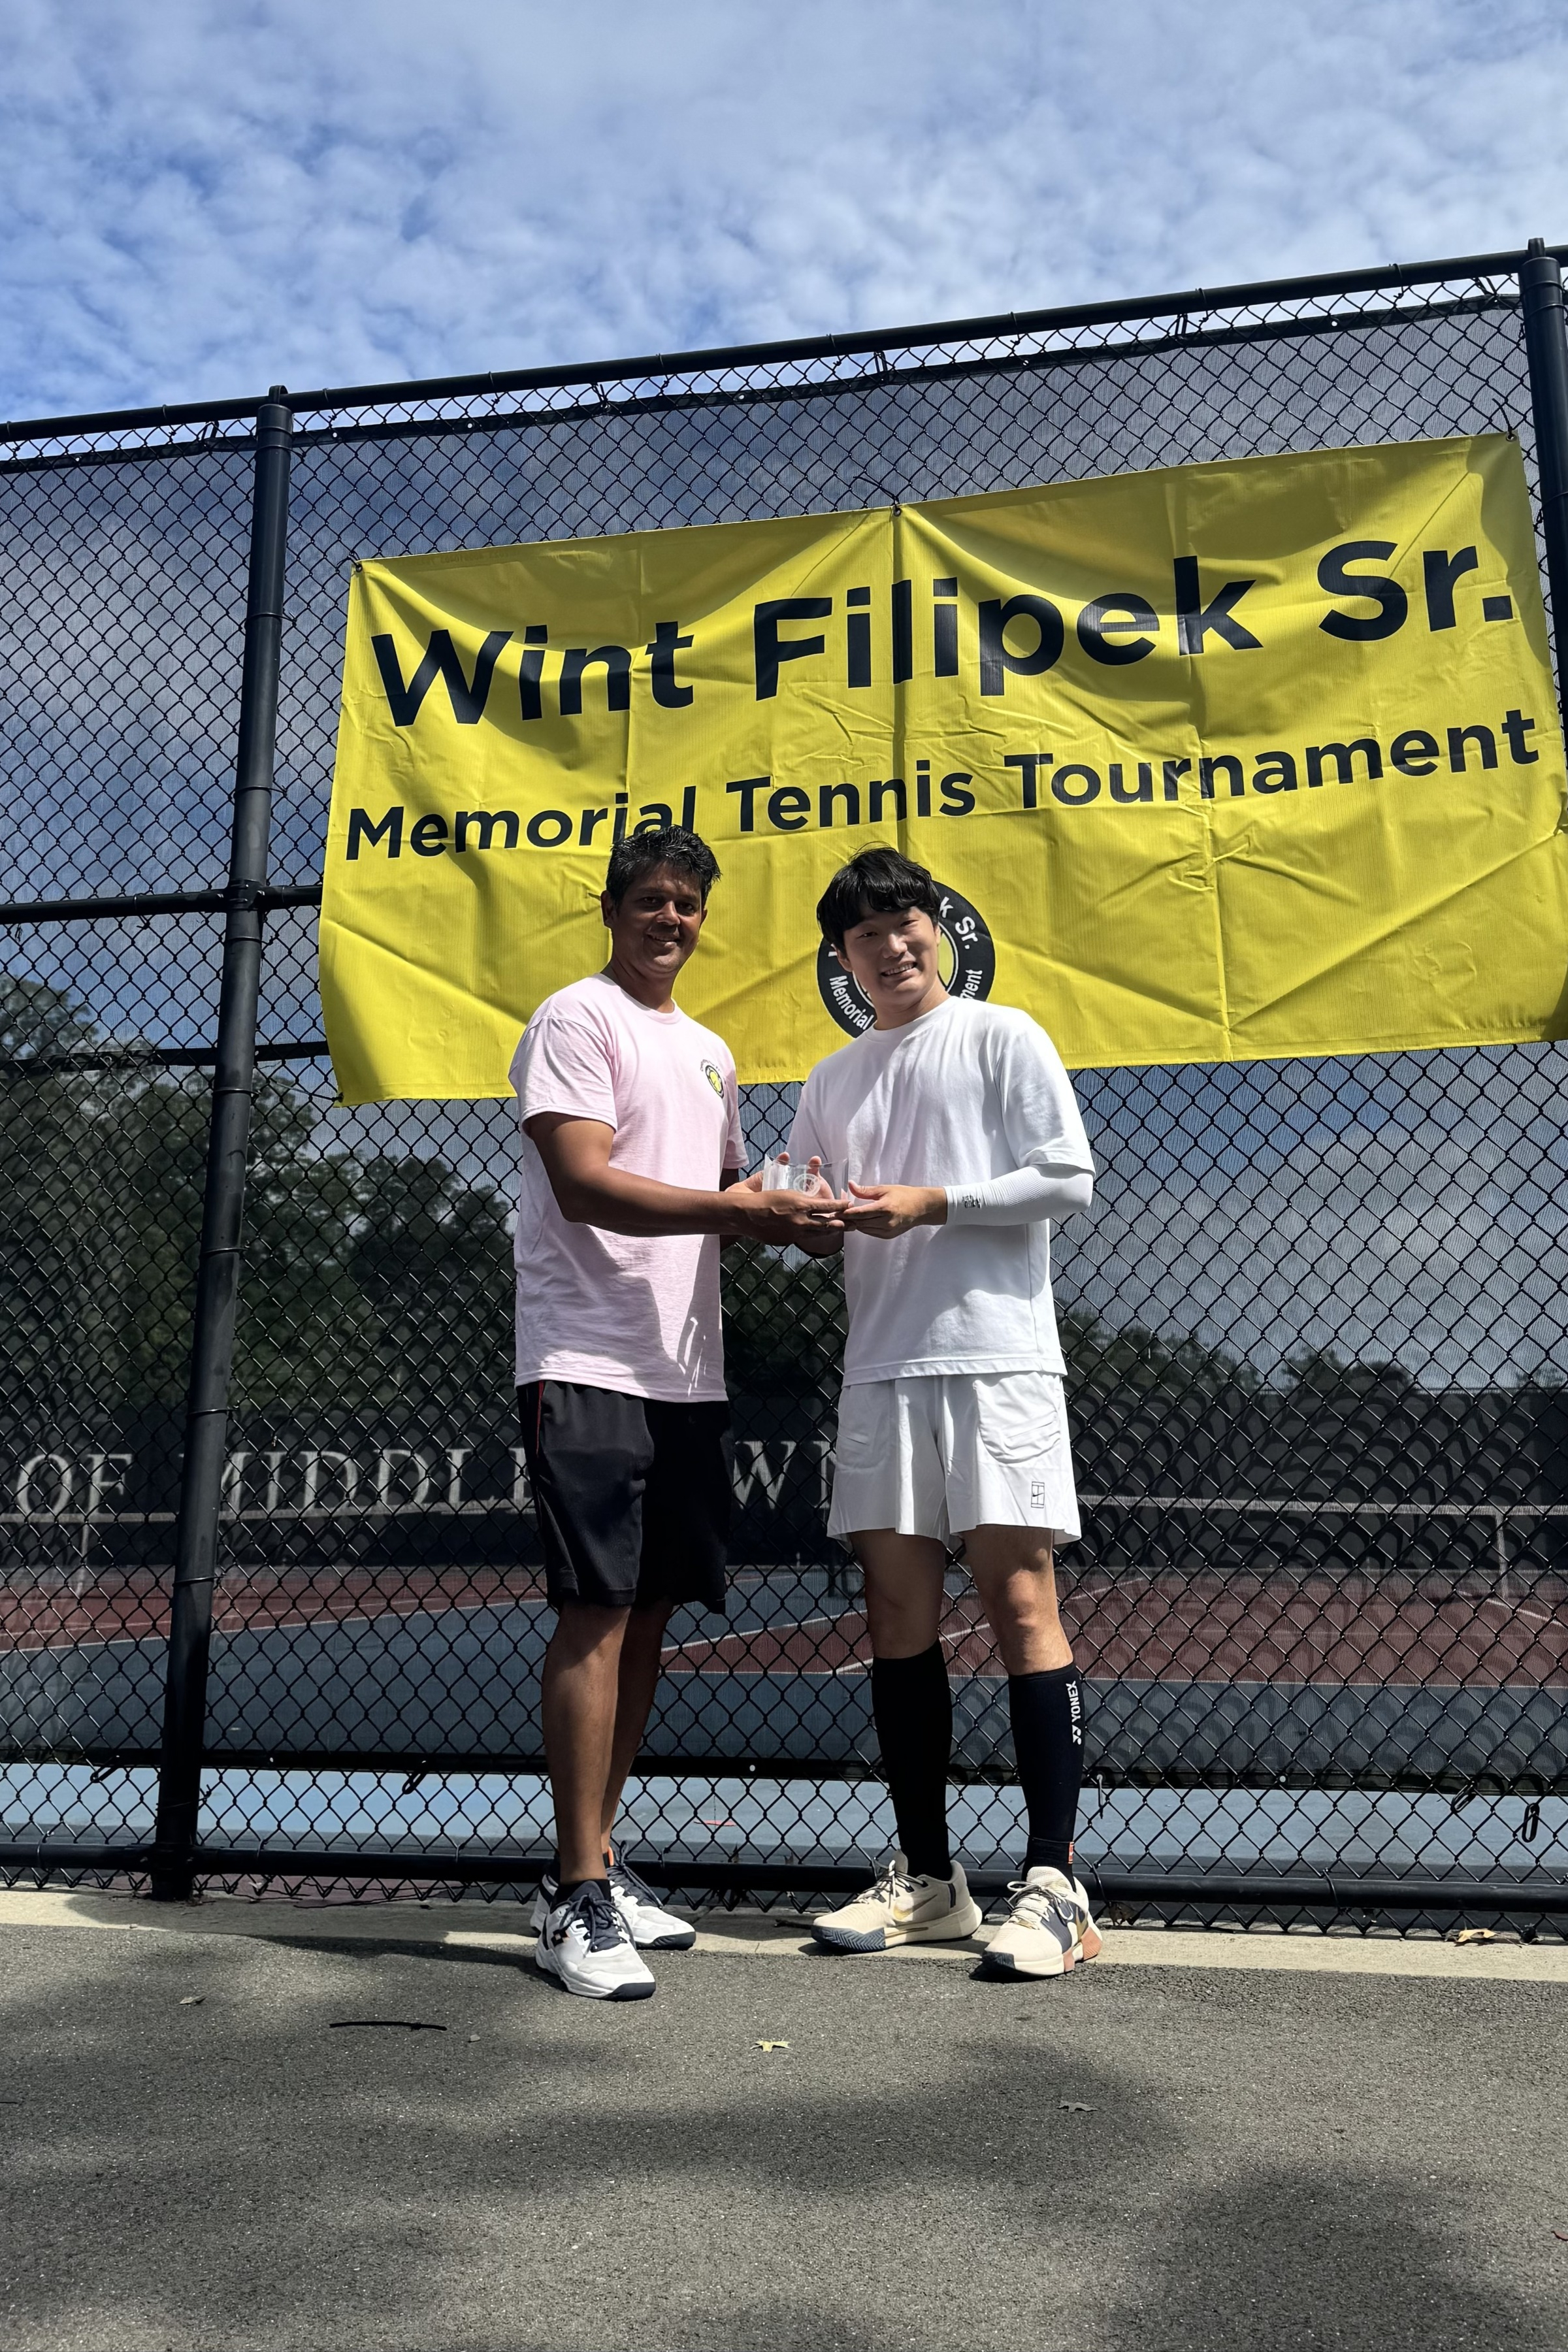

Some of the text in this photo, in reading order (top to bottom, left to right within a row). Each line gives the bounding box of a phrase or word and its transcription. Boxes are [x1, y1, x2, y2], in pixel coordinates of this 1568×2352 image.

[370, 540, 1514, 727] Wint Filipek Sr.
[346, 709, 1540, 861] Memorial Tennis Tournament
[955, 915, 979, 950] Sr.
[828, 975, 875, 1031] Memorial
[16, 1453, 133, 1517] OF
[1065, 1680, 1081, 1723] YONEX
